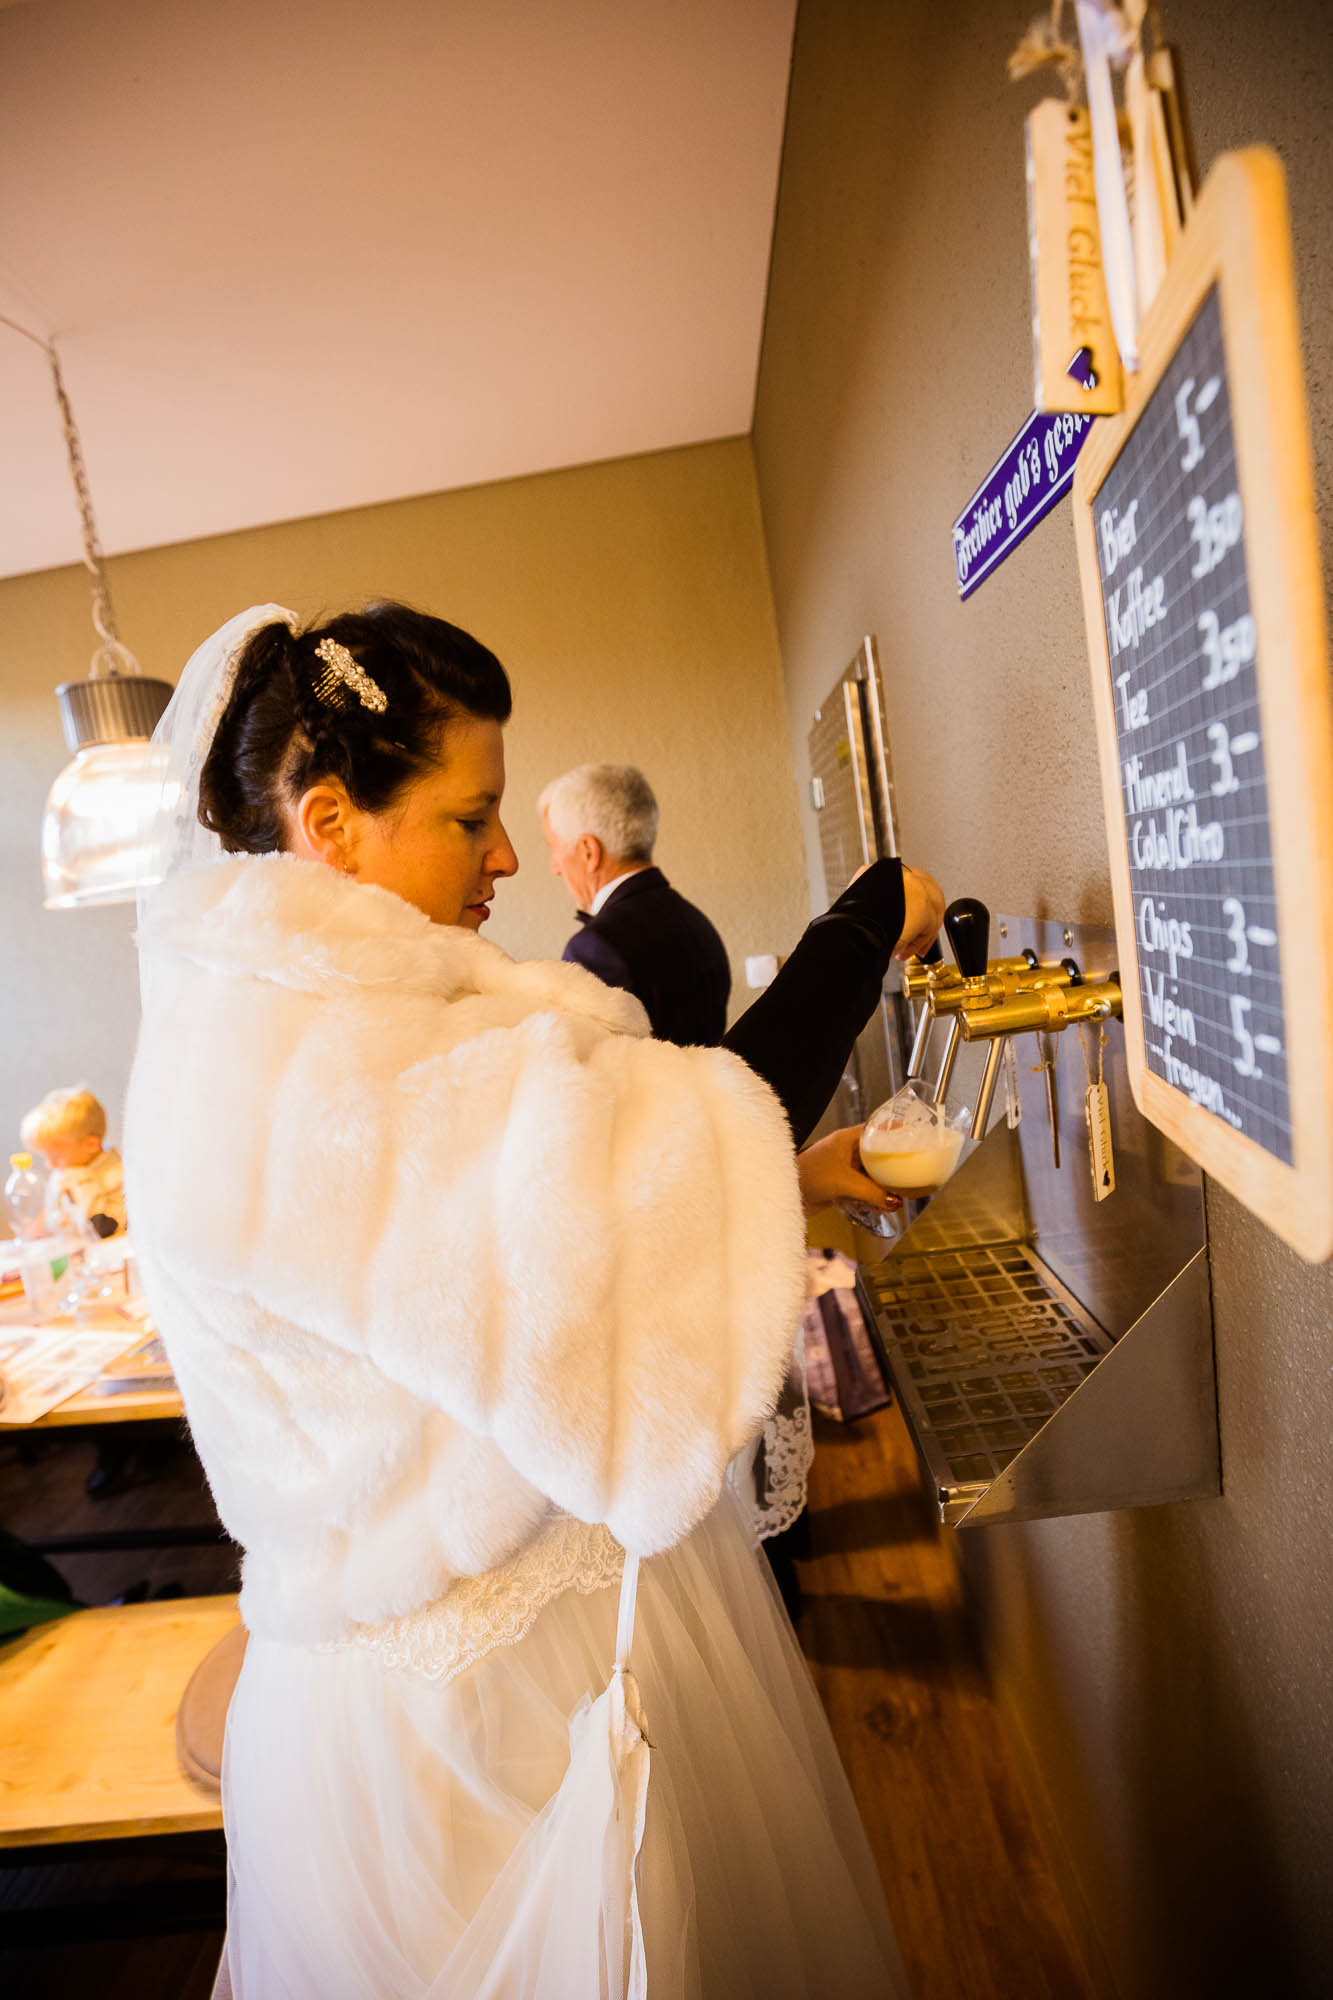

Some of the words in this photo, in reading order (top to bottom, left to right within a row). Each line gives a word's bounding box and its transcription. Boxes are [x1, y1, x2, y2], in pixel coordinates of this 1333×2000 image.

[1101, 499, 1138, 576] Bier
[1109, 566, 1168, 656] Kaffee
[1116, 671, 1149, 730] Tee
[1125, 740, 1194, 813] Mineral
[1140, 897, 1194, 979] Chips
[1144, 966, 1196, 1047] Wein
